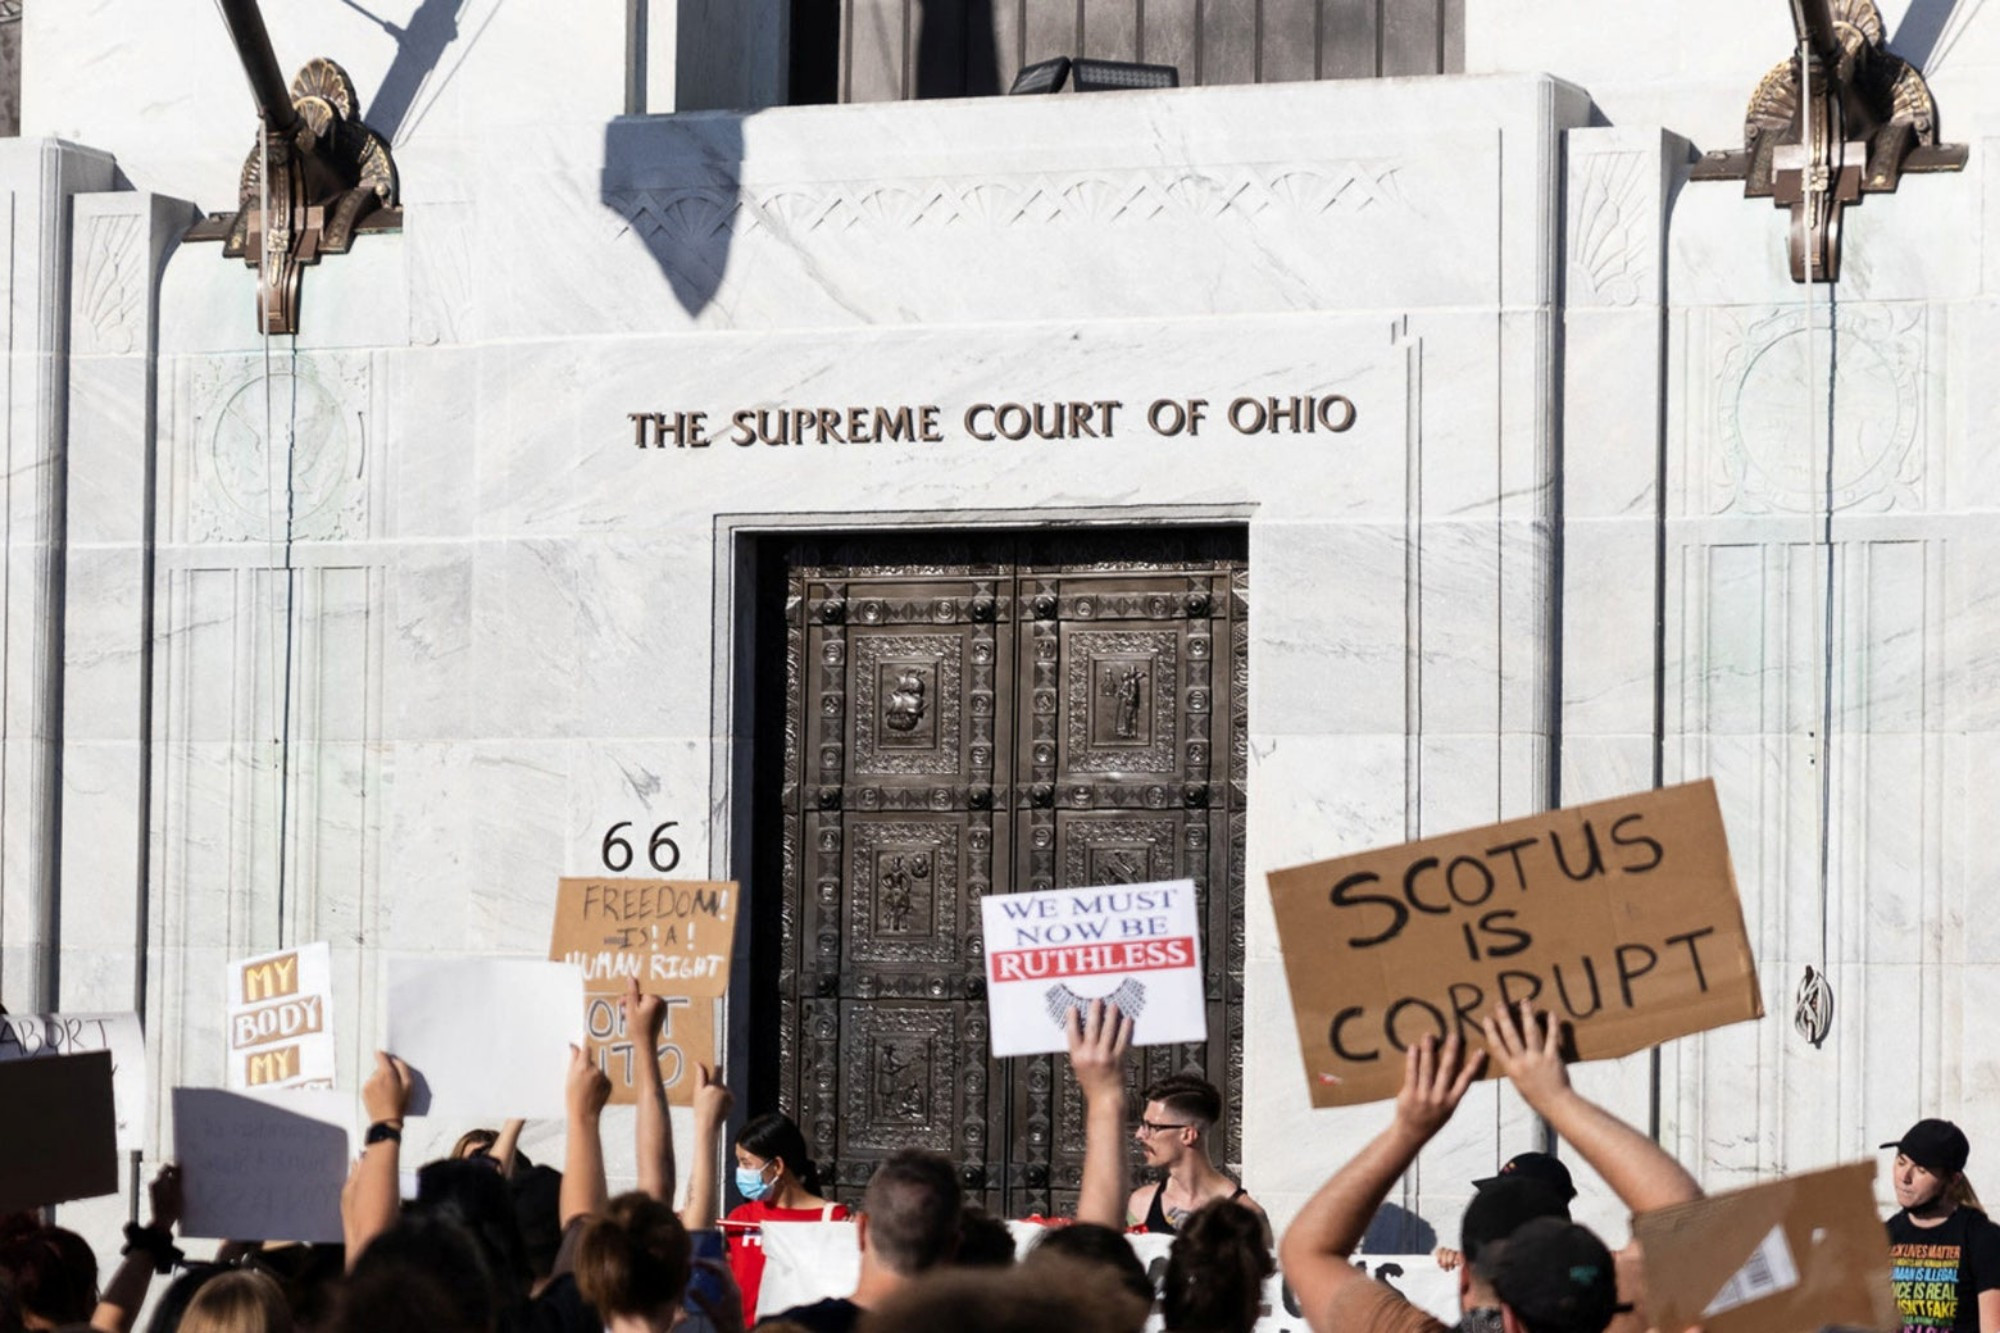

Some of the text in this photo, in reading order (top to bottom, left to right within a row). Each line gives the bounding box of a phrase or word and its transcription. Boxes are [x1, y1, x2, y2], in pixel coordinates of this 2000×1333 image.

[628, 394, 1357, 448] THE SUPREME COURT OF OHIO
[602, 821, 680, 872] 66
[1329, 813, 1664, 949] SCOTUS
[1001, 888, 1178, 919] WE MUST
[1016, 916, 1169, 946] NOW BE
[1462, 909, 1533, 961] IS
[651, 954, 724, 980] RIGHT
[1000, 940, 1187, 979] RUTHLESS
[246, 957, 294, 1001] MY
[235, 996, 320, 1046] BODY
[250, 1048, 290, 1085] MY
[1928, 1245, 1960, 1258] MATTER
[1914, 1282, 1926, 1299] IS
[1926, 1282, 1958, 1300] REAL
[1926, 1300, 1957, 1318] FAKE
